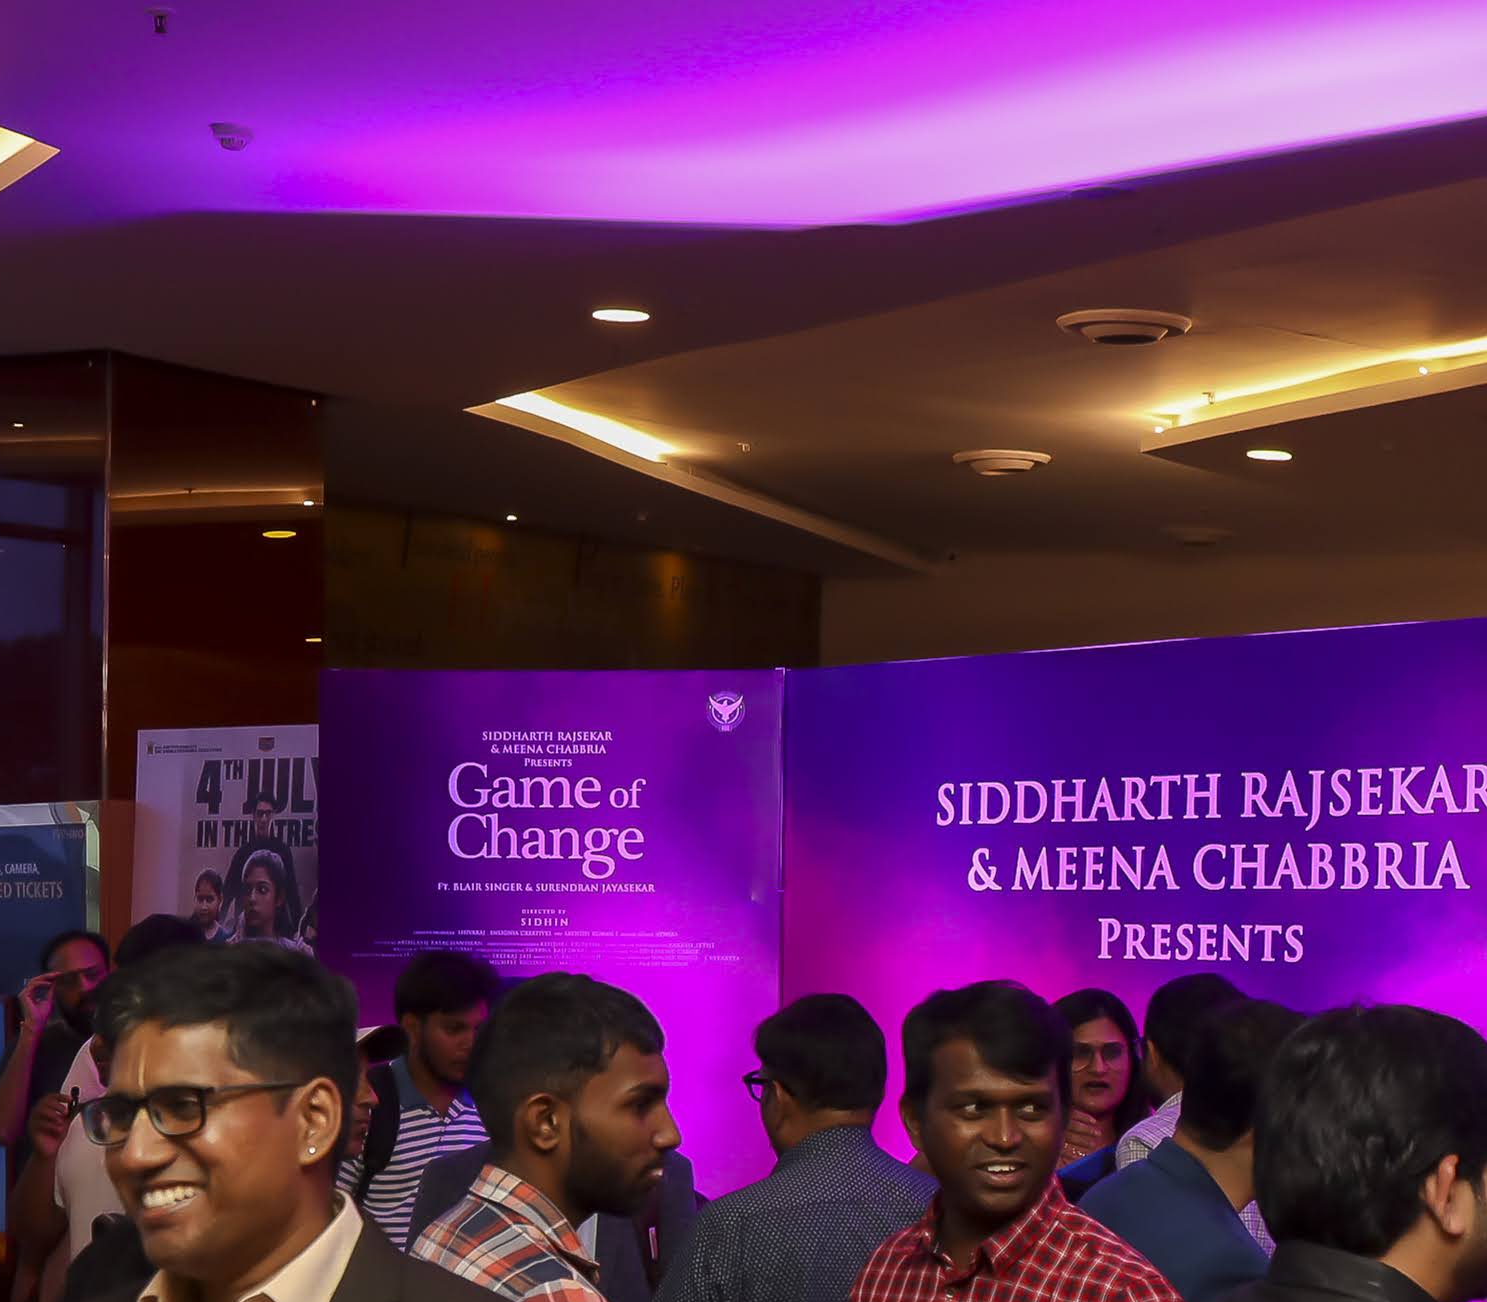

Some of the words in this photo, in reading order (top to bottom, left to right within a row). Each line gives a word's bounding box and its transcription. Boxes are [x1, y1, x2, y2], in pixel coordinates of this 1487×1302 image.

[482, 731, 553, 741] SIDDHARTH
[557, 731, 613, 742] RAJSEKAR
[491, 744, 500, 754] &
[502, 744, 543, 754] MEENA
[546, 744, 607, 754] CHABBRIA
[242, 757, 319, 815] JUL
[448, 762, 602, 808] Game
[609, 778, 647, 809] of
[936, 772, 1221, 827] SIDDHARTH
[196, 820, 219, 848] IN
[448, 813, 645, 880] Change
[967, 847, 1002, 892] &
[1011, 845, 1180, 891] MEENA
[1193, 840, 1470, 890] CHABBRIA
[15, 881, 63, 898] TICKETS
[453, 882, 482, 891] BLAIR
[485, 882, 523, 892] SINGER
[525, 883, 533, 891] &
[535, 883, 599, 892] SURENDRAN
[602, 884, 656, 894] JAYASEKAR
[521, 917, 569, 927] SIDHIN
[1097, 918, 1305, 963] PRESENTS
